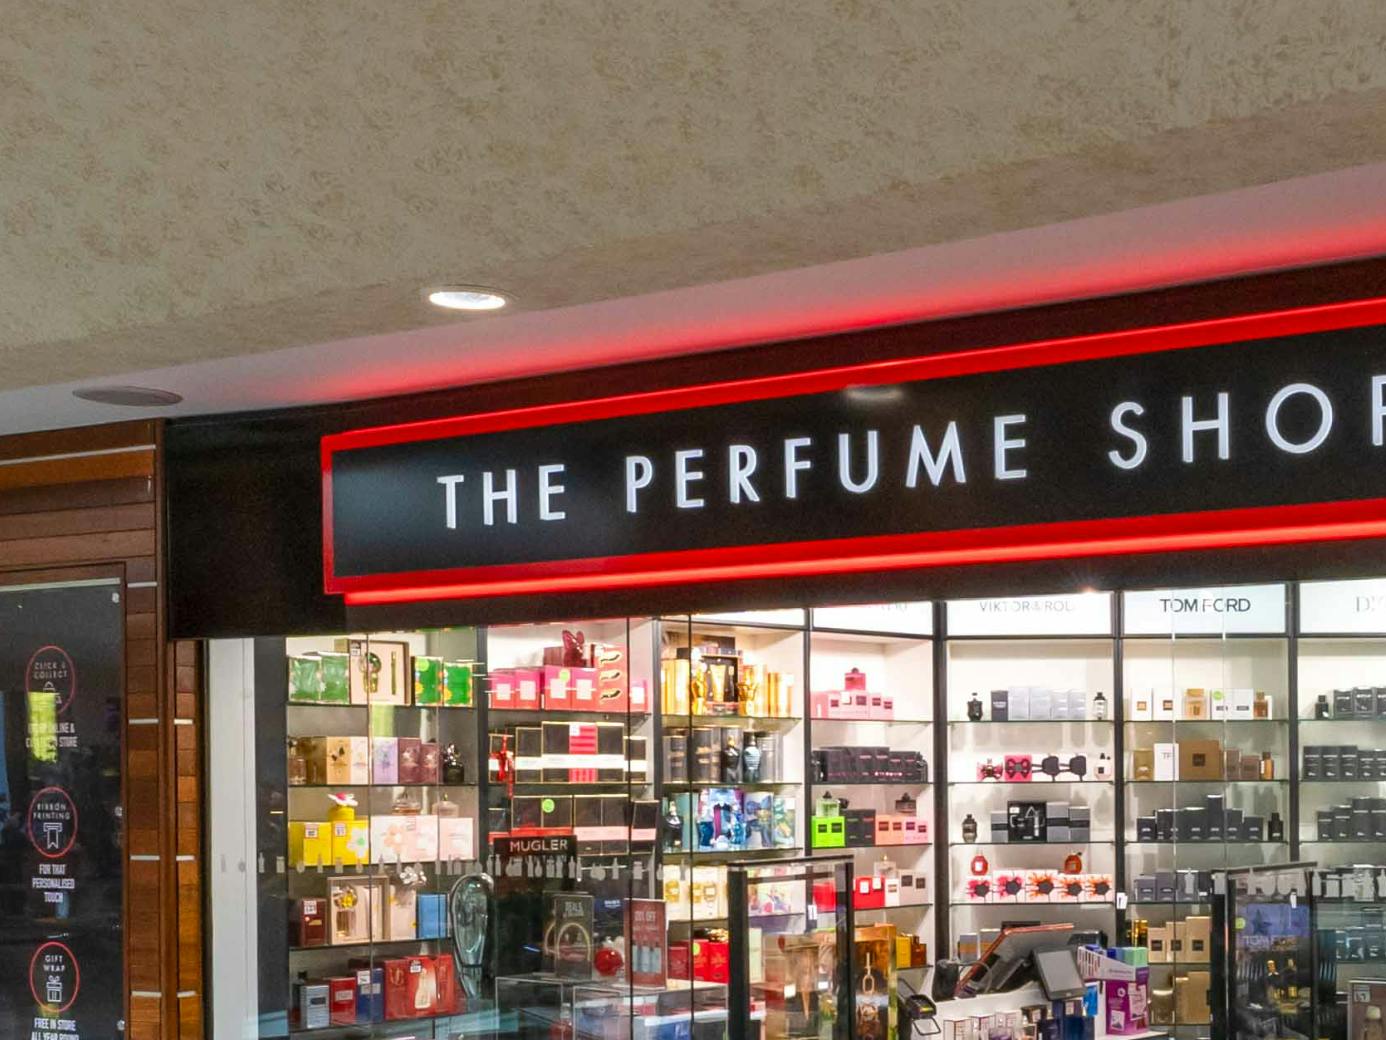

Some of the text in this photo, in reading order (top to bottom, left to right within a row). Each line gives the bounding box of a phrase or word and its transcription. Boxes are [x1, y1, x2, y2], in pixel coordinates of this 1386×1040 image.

[437, 464, 567, 529] THE
[626, 414, 1028, 513] PERFUME
[1160, 598, 1251, 613] TOM FORD
[33, 670, 67, 679] COLLECT
[36, 803, 66, 811] RIBBON
[33, 811, 71, 820] PRINTING
[510, 839, 567, 852] MUGLER
[39, 864, 51, 875] FOR
[45, 955, 63, 963] GIFT
[34, 1017, 49, 1029] FREE
